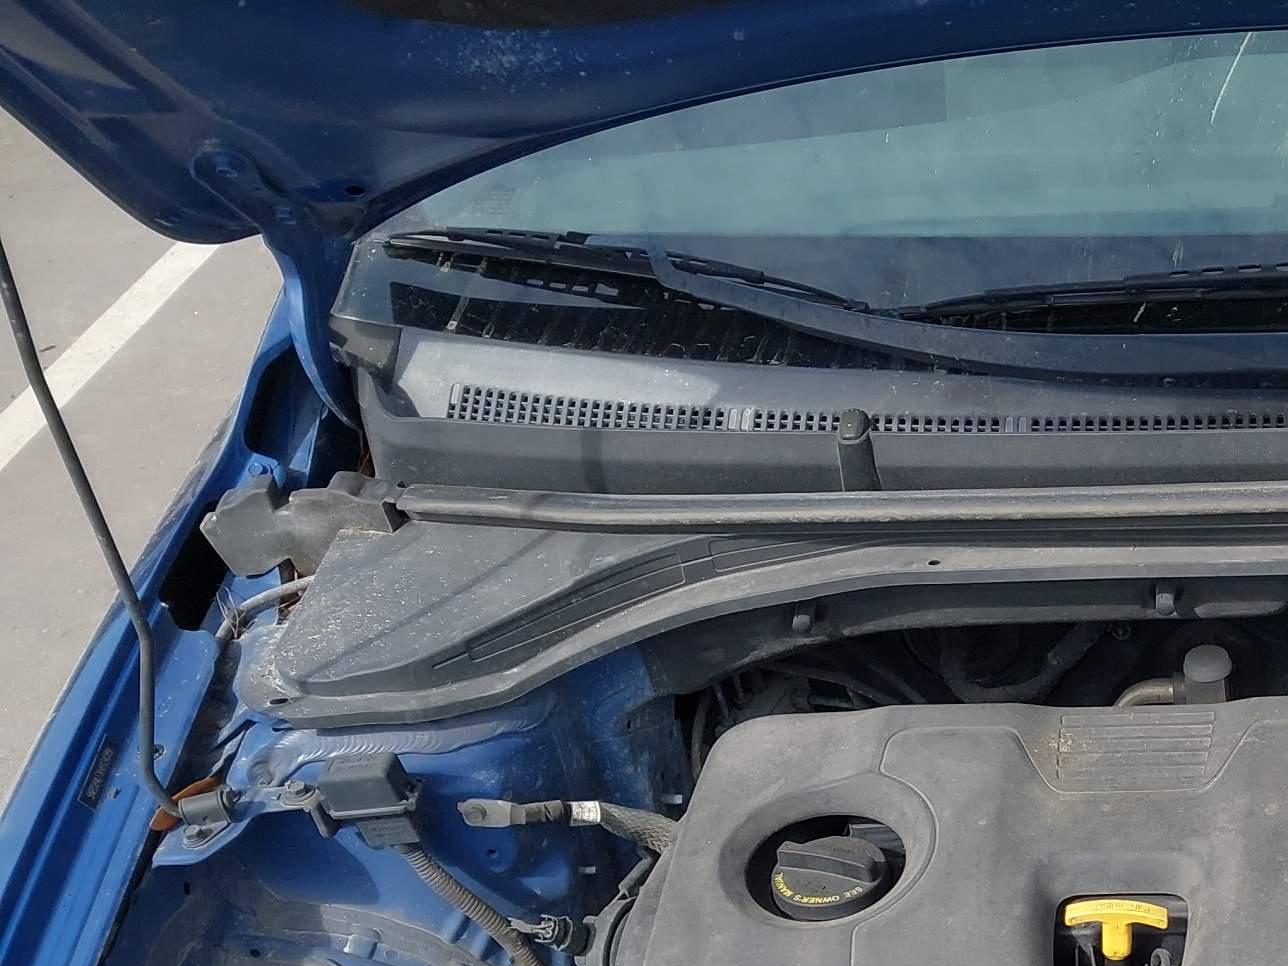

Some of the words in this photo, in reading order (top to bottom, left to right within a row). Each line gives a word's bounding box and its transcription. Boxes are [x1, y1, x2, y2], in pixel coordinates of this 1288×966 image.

[773, 871, 794, 898] MANUAL
[842, 885, 863, 898] SEE
[792, 894, 840, 905] OWNER'S
